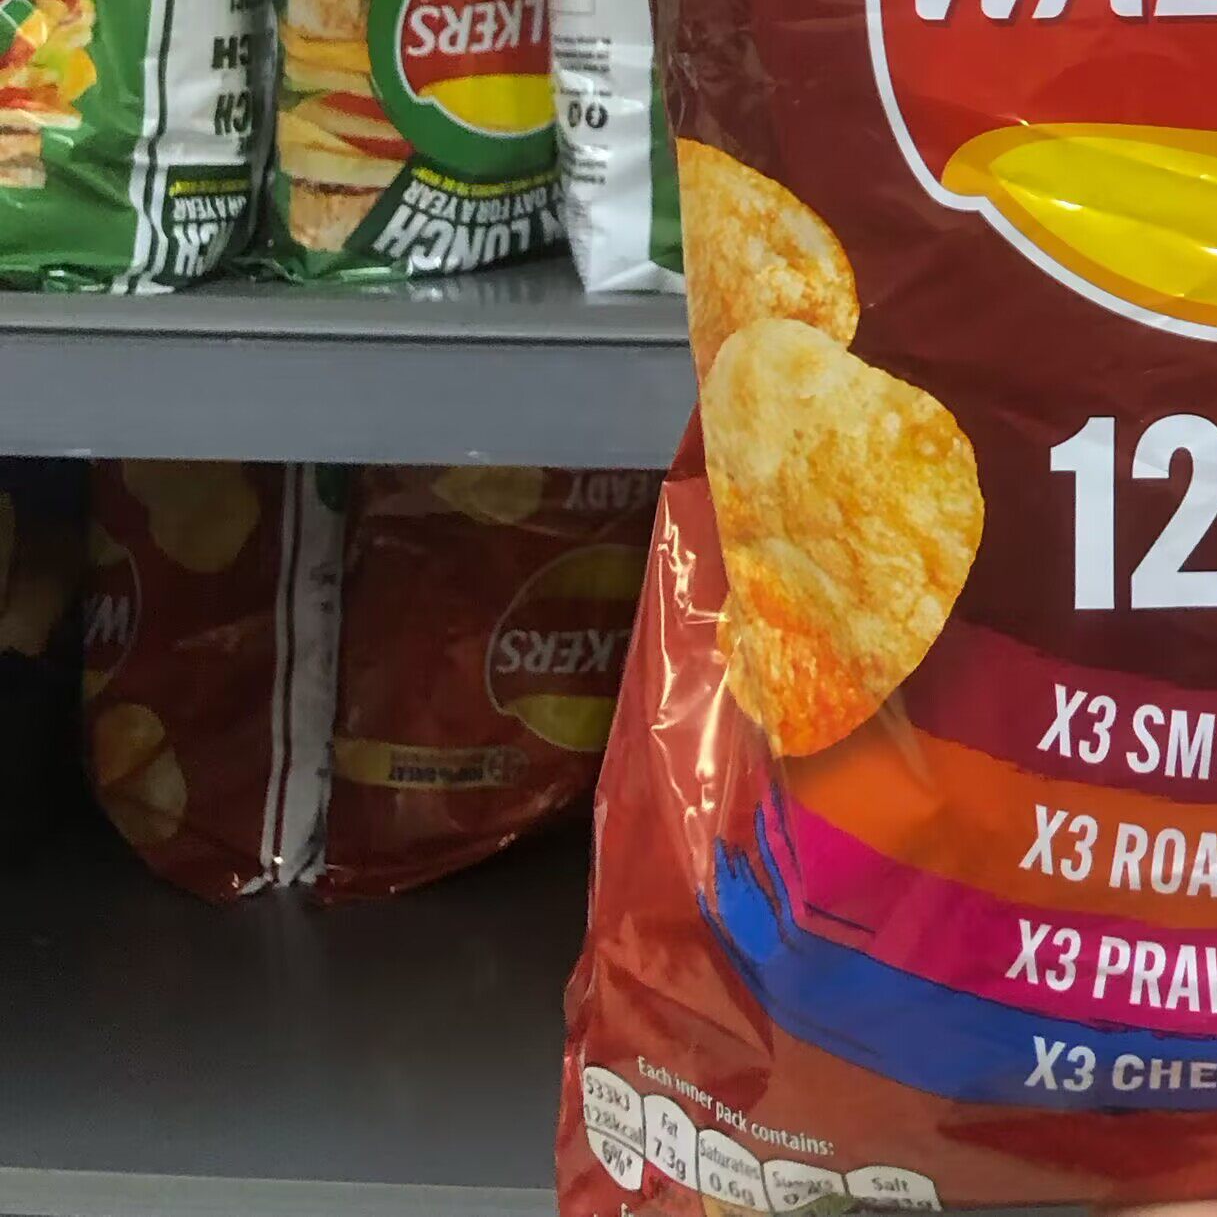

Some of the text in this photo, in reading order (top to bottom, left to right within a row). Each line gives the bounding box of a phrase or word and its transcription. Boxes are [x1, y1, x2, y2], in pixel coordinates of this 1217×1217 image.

[173, 196, 218, 222] YEAR
[402, 179, 457, 222] YEAR
[373, 203, 531, 275] LUNCH
[1037, 684, 1118, 764] X3
[1018, 804, 1099, 882] X3
[1006, 919, 1082, 991] X3
[1025, 1036, 1098, 1092] X3
[637, 1055, 835, 1156] Each inner pack contains:
